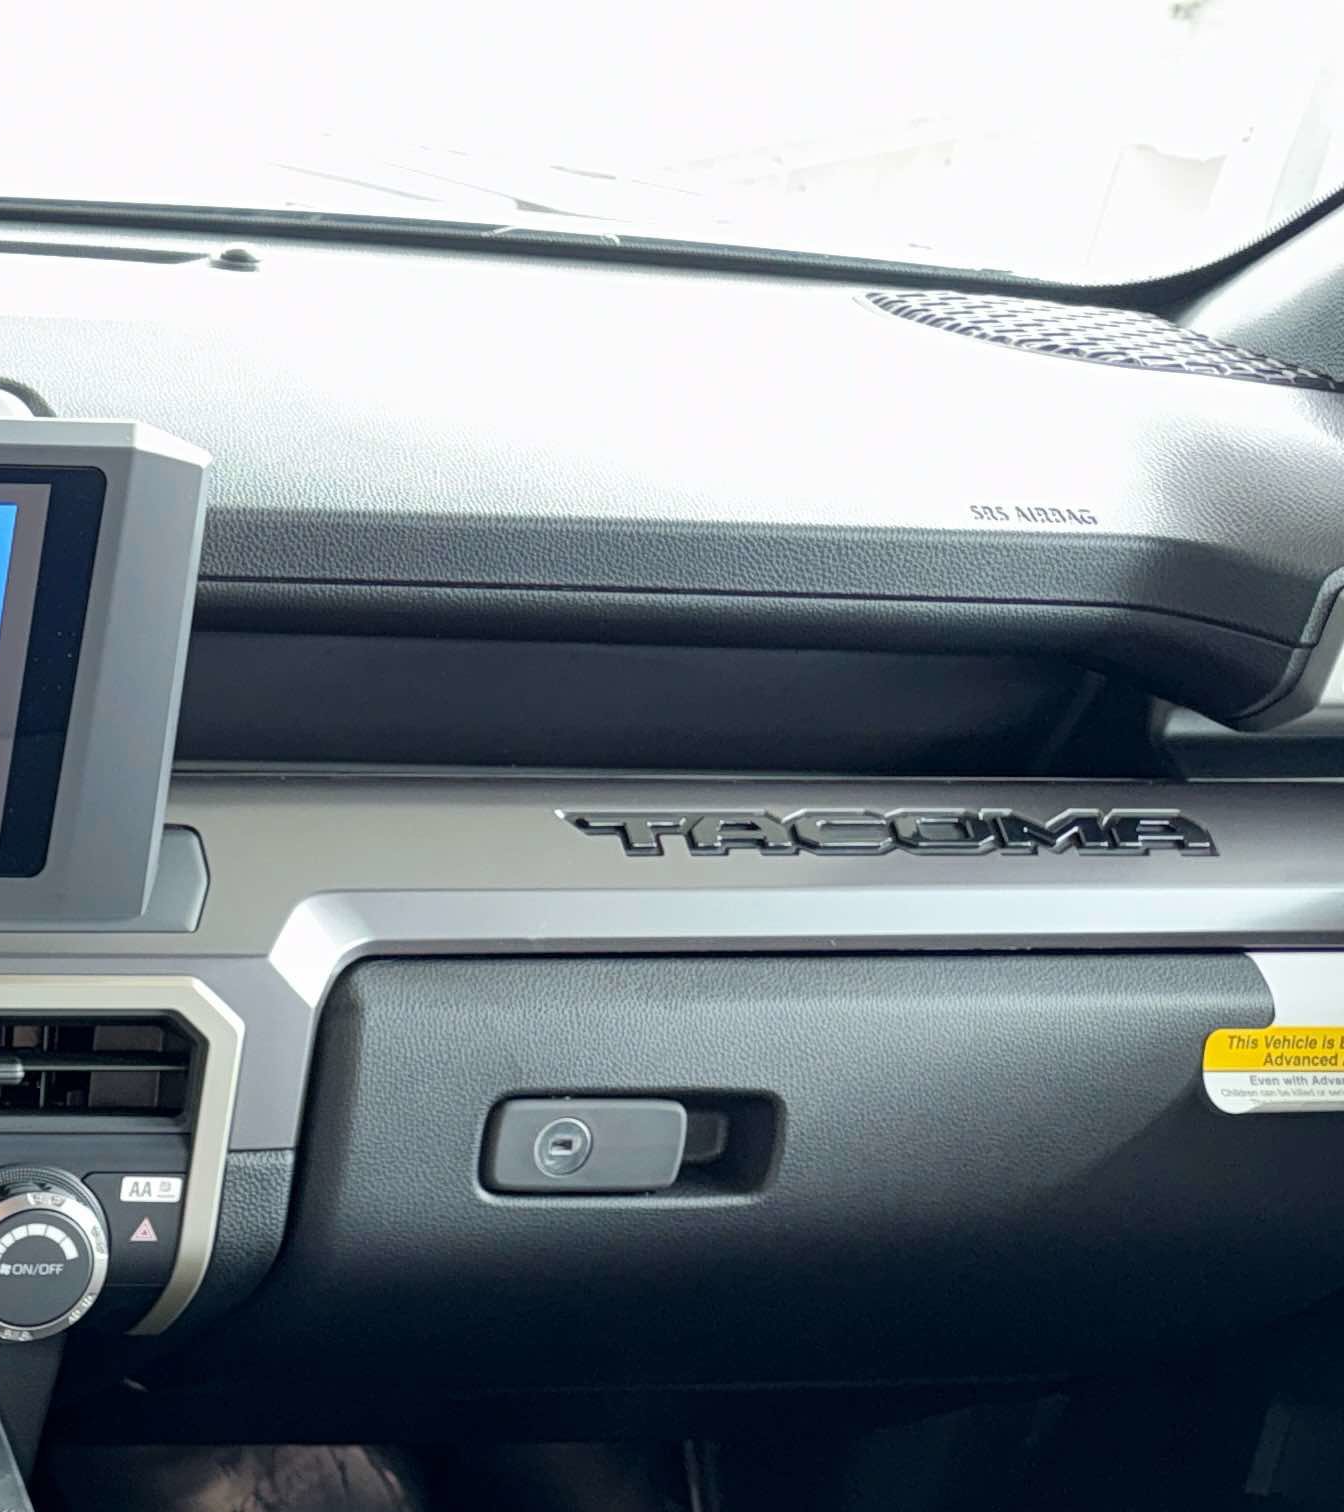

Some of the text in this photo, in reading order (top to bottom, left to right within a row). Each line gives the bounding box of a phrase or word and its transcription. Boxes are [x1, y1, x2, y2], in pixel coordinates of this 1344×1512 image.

[1014, 505, 1099, 526] AIRBAG
[553, 807, 1221, 857] TACOMA
[1227, 1035, 1258, 1049] This
[1265, 1034, 1318, 1049] Vehicle
[1322, 1035, 1334, 1049] is
[1263, 1052, 1338, 1067] Advanced
[1249, 1075, 1280, 1086] Even
[1281, 1075, 1308, 1086] with
[128, 1181, 152, 1197] AA
[12, 1263, 64, 1275] ON/OFF
